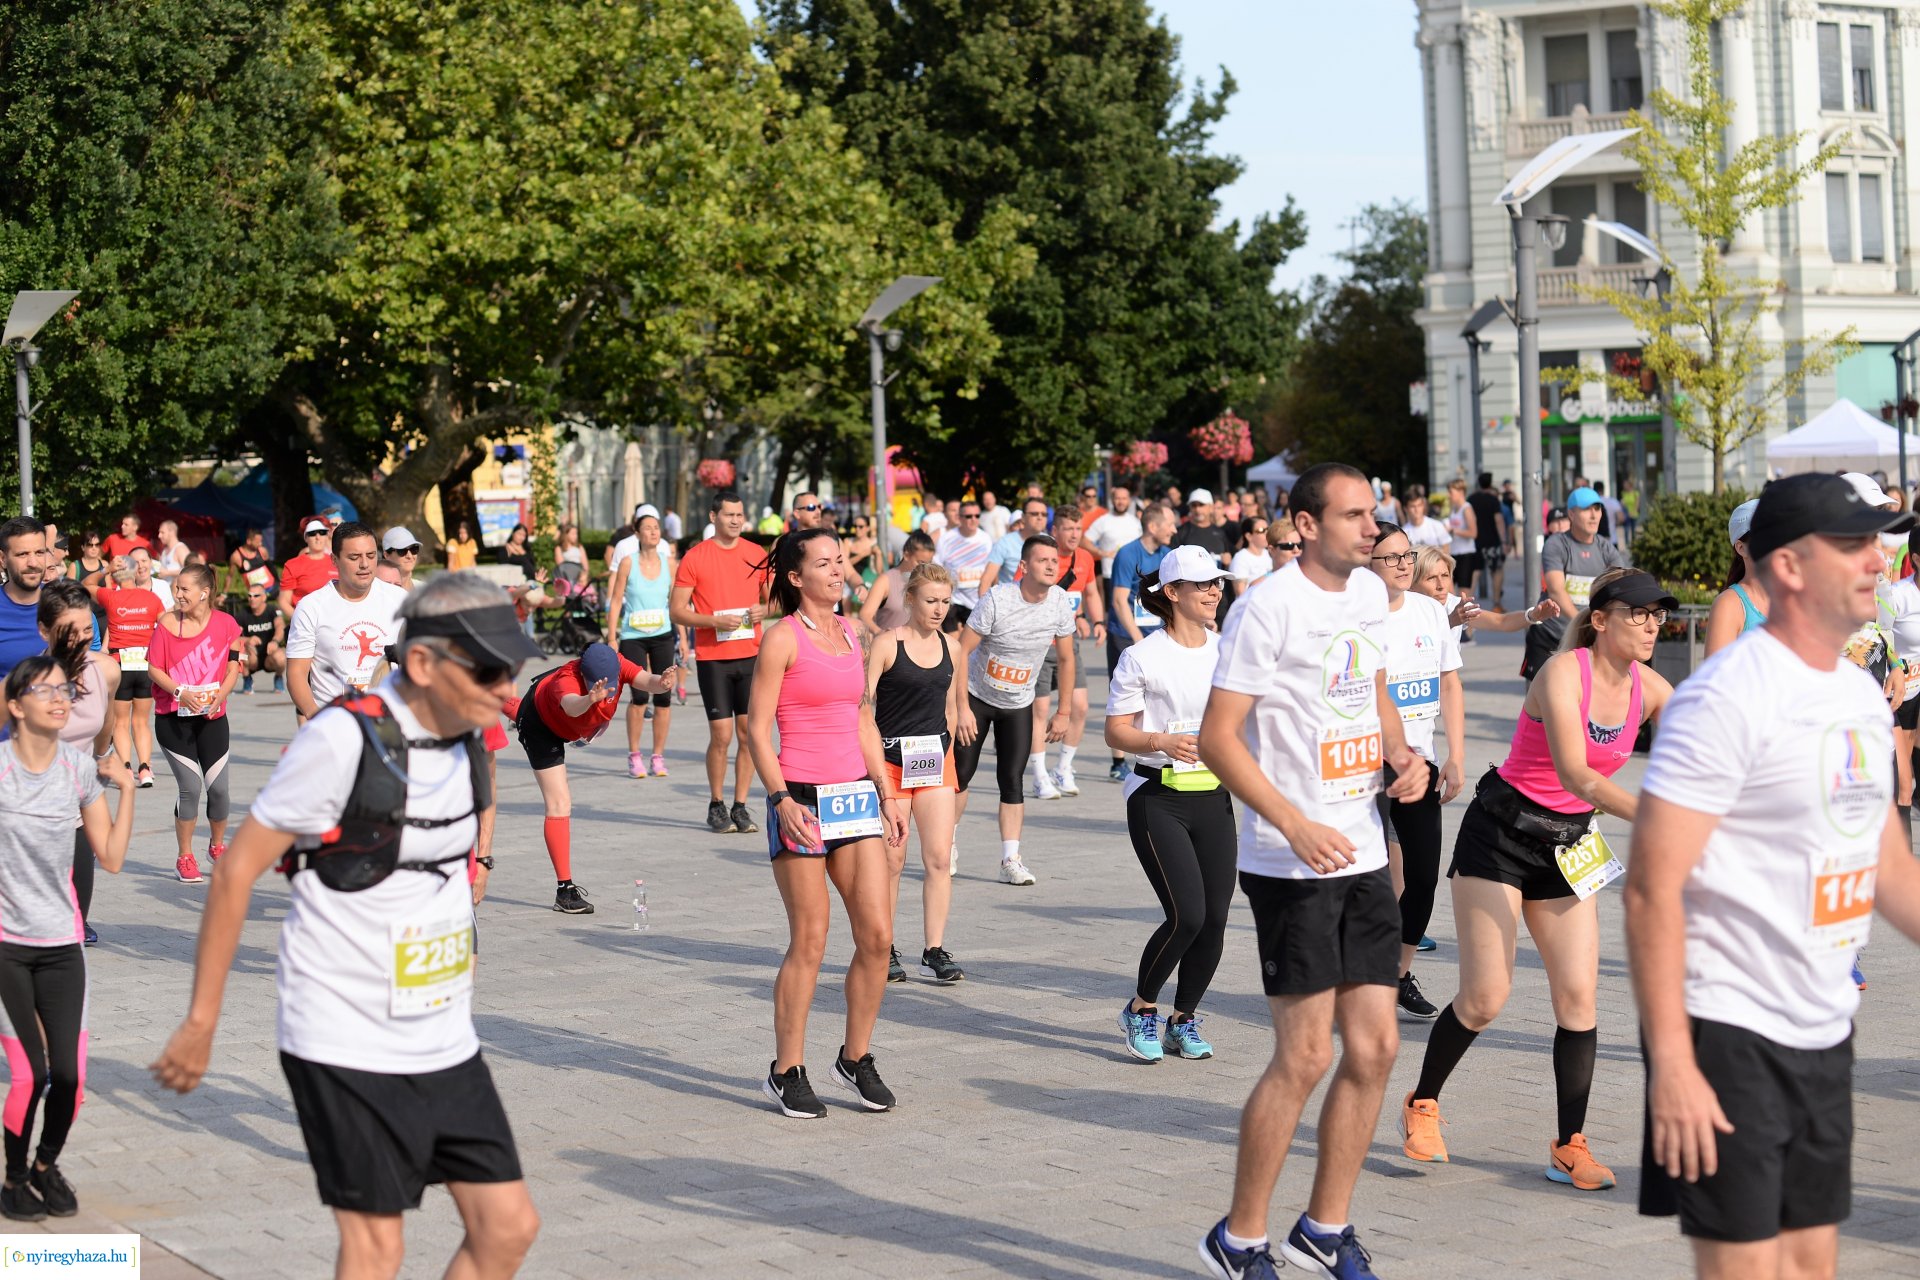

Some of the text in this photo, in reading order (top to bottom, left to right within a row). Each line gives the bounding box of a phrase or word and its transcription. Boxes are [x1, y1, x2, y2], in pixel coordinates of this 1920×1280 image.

[247, 621, 273, 633] POLICE
[169, 635, 219, 685] NIKE
[991, 663, 1027, 681] 1110
[1397, 680, 1432, 701] 608
[1328, 735, 1379, 769] 1019
[910, 758, 936, 770] 208
[831, 793, 870, 815] 617
[1560, 837, 1600, 876] 2267
[403, 932, 469, 976] 2285
